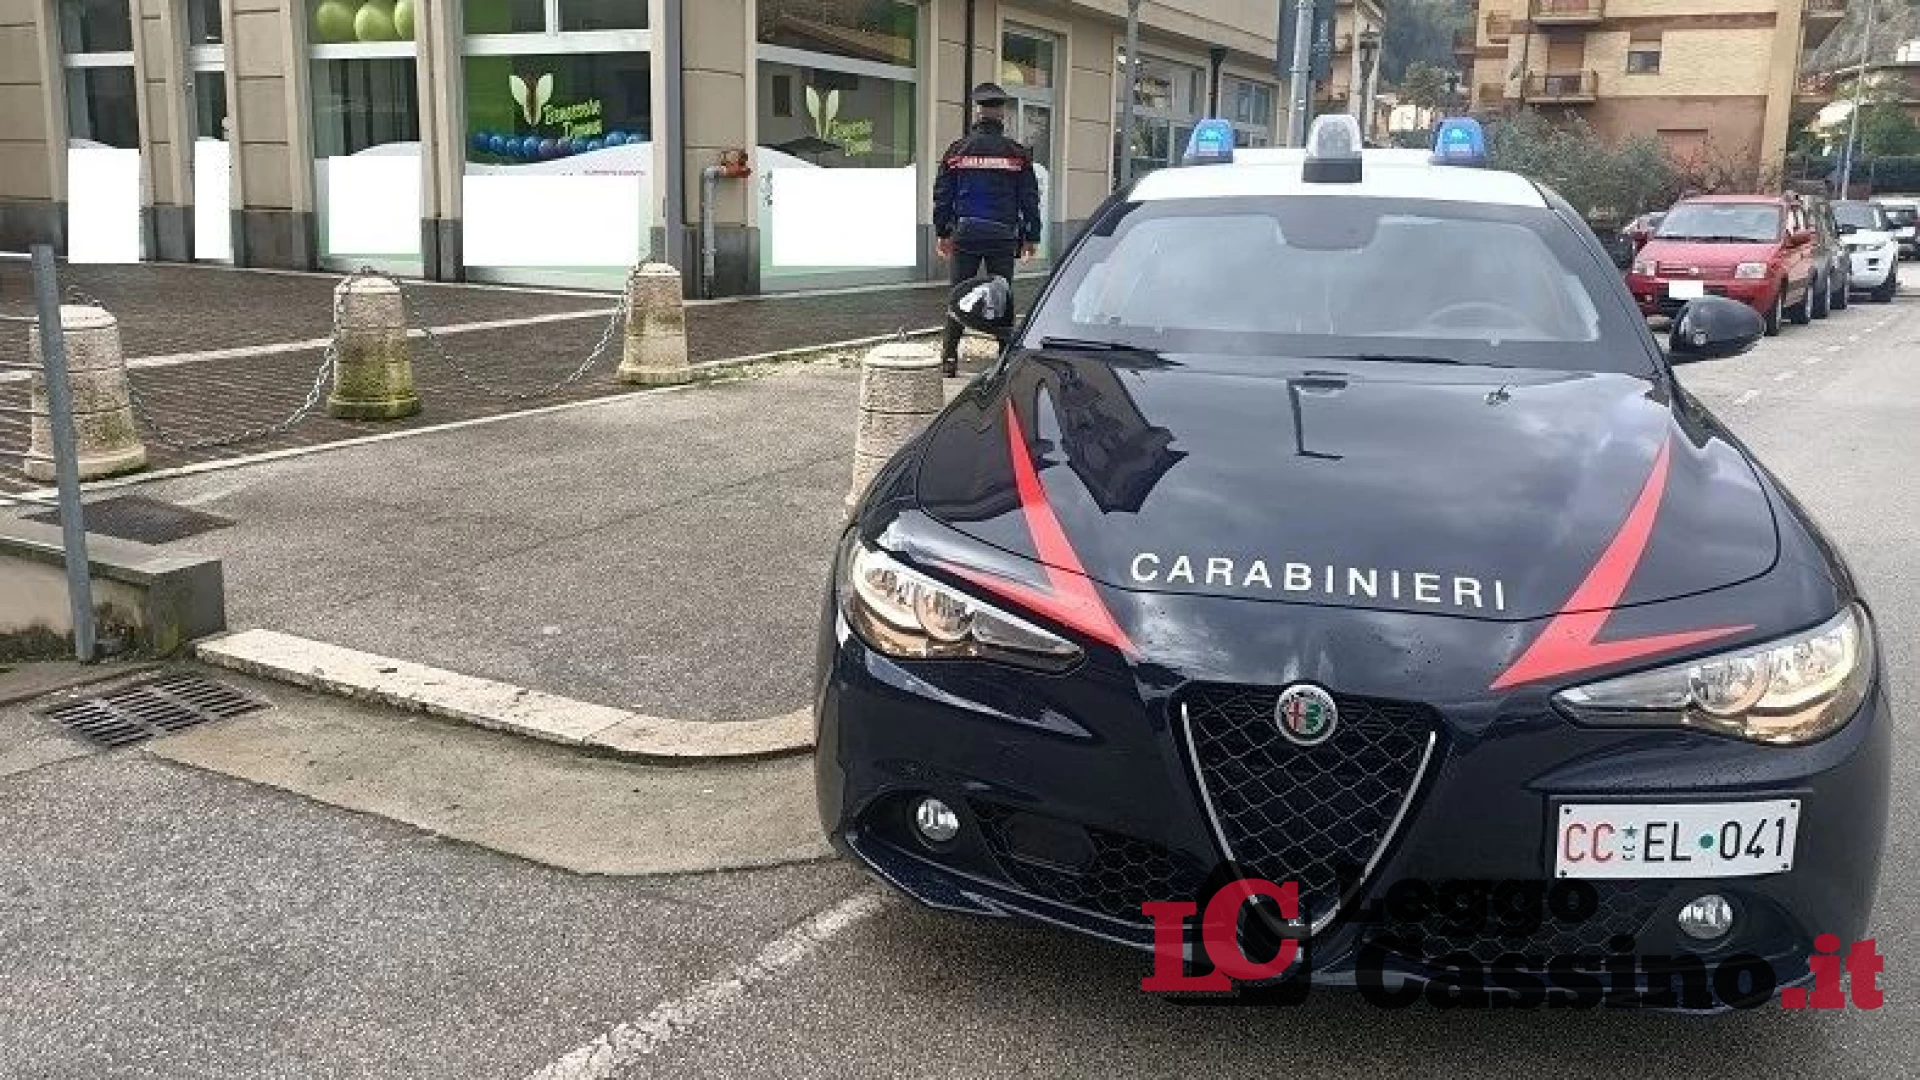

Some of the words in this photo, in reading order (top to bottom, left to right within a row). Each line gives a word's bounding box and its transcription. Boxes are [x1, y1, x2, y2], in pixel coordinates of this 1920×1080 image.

[1130, 553, 1504, 610] CARABINIERI
[1563, 823, 1616, 863] CC
[1643, 821, 1692, 862] EL
[1719, 816, 1787, 860] 041
